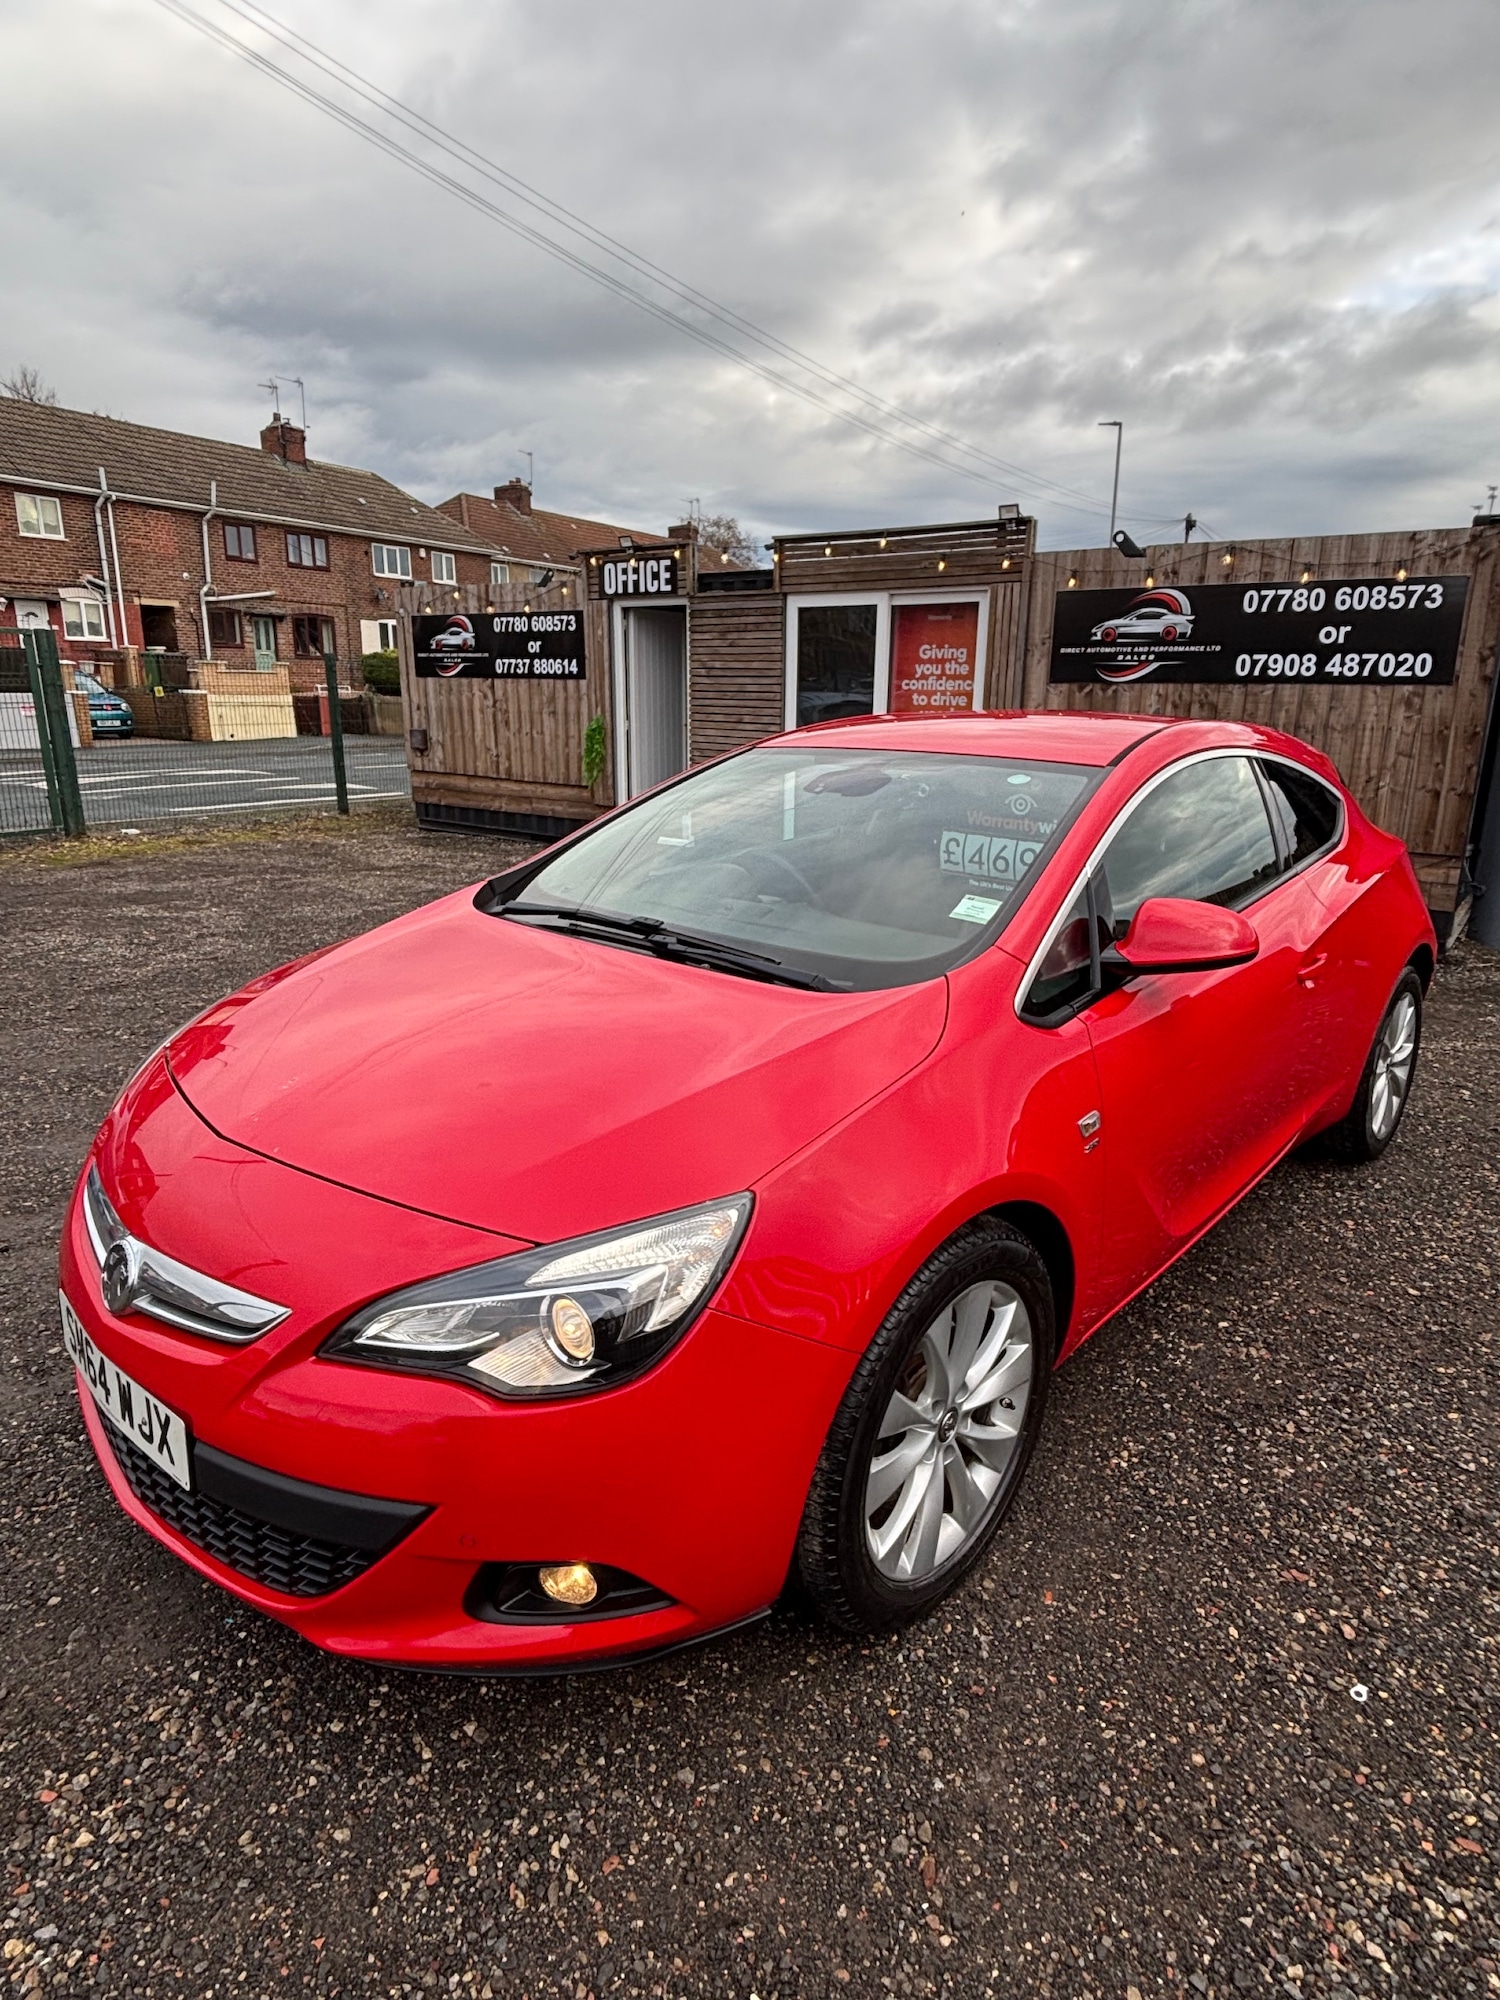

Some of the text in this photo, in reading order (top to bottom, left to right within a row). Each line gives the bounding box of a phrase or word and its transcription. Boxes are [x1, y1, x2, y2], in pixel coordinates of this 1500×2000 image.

[604, 559, 672, 595] OFFICE
[1243, 584, 1443, 613] 07780 608573
[493, 615, 576, 633] 07780 608573
[1319, 625, 1351, 644] or
[528, 641, 542, 653] or
[919, 644, 967, 662] Giving
[495, 659, 578, 674] 07737 880614
[915, 661, 969, 678] you the
[1235, 653, 1433, 677] 07908 487020
[902, 676, 974, 690] confidenc
[912, 692, 967, 706] to drive
[116, 1371, 175, 1466] WJX
